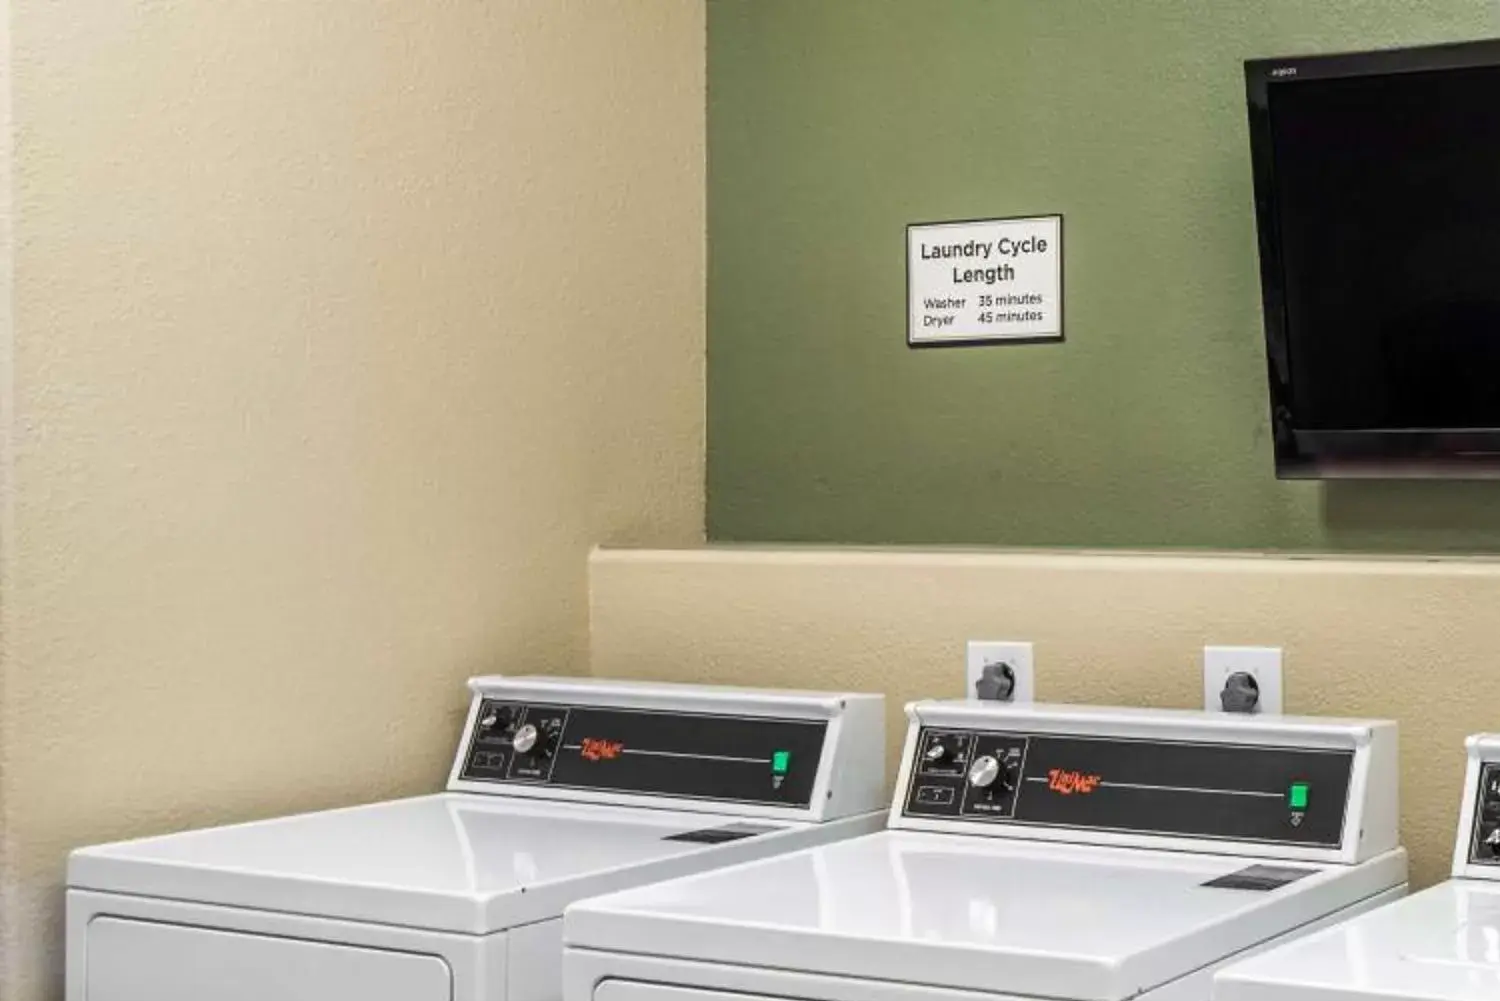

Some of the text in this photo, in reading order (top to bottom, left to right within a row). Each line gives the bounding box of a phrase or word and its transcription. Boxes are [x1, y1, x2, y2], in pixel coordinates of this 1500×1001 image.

[921, 236, 1048, 260] Laundry Cycle
[953, 264, 1015, 284] Length
[924, 293, 1043, 309] Washer 35 minutes
[923, 310, 1043, 328] Dryer 45 minutes
